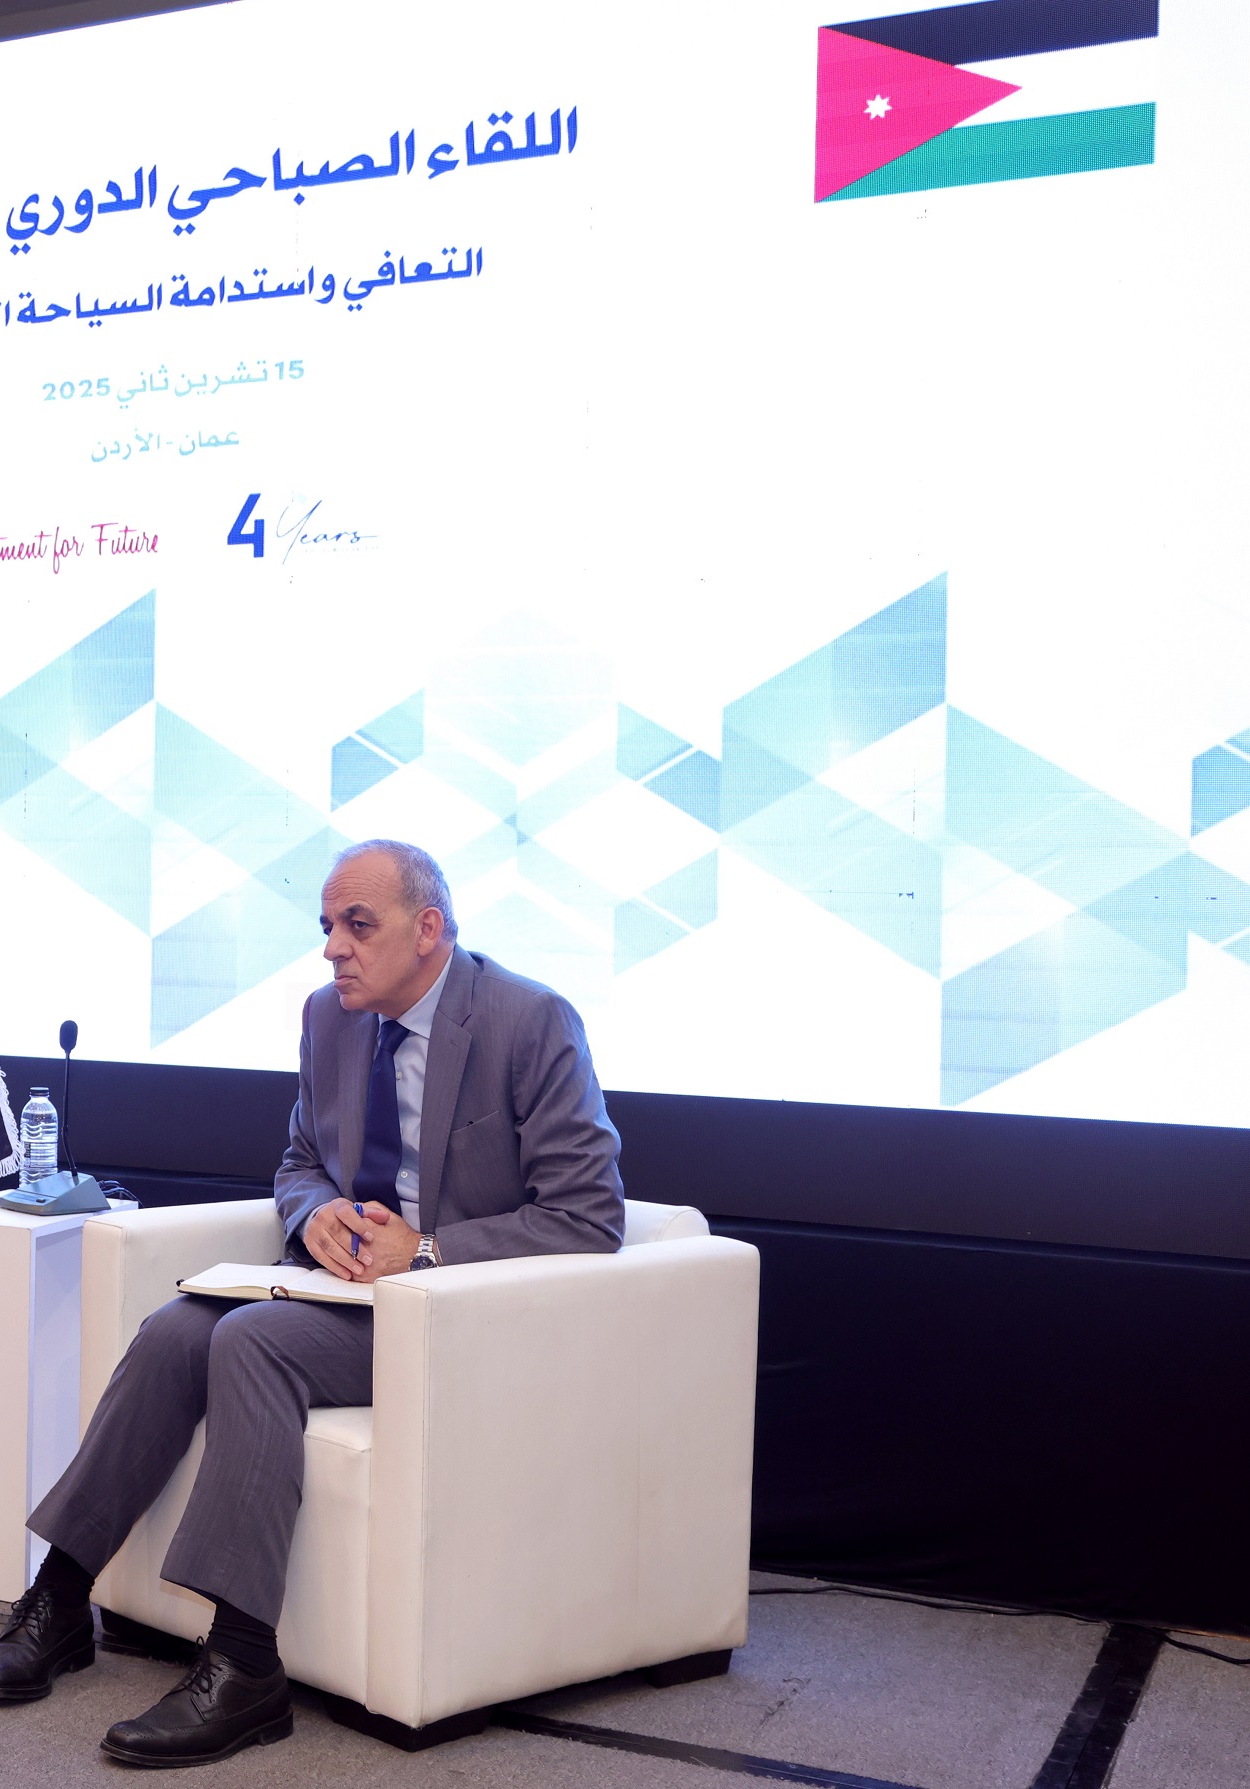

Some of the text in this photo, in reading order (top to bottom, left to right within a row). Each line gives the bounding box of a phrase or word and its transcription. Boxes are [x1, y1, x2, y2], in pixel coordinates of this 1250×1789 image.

[427, 105, 578, 179] اللقاء
[6, 164, 158, 256] الدوري
[167, 128, 416, 236] الصباحي
[17, 283, 162, 329] السياحة
[169, 266, 335, 307] واستدامة
[343, 247, 483, 313] التعافي
[41, 359, 305, 410] 15 تشرين ثاني 2025
[52, 526, 85, 575] for
[91, 522, 159, 556] Future
[227, 493, 379, 566] 4 Years
